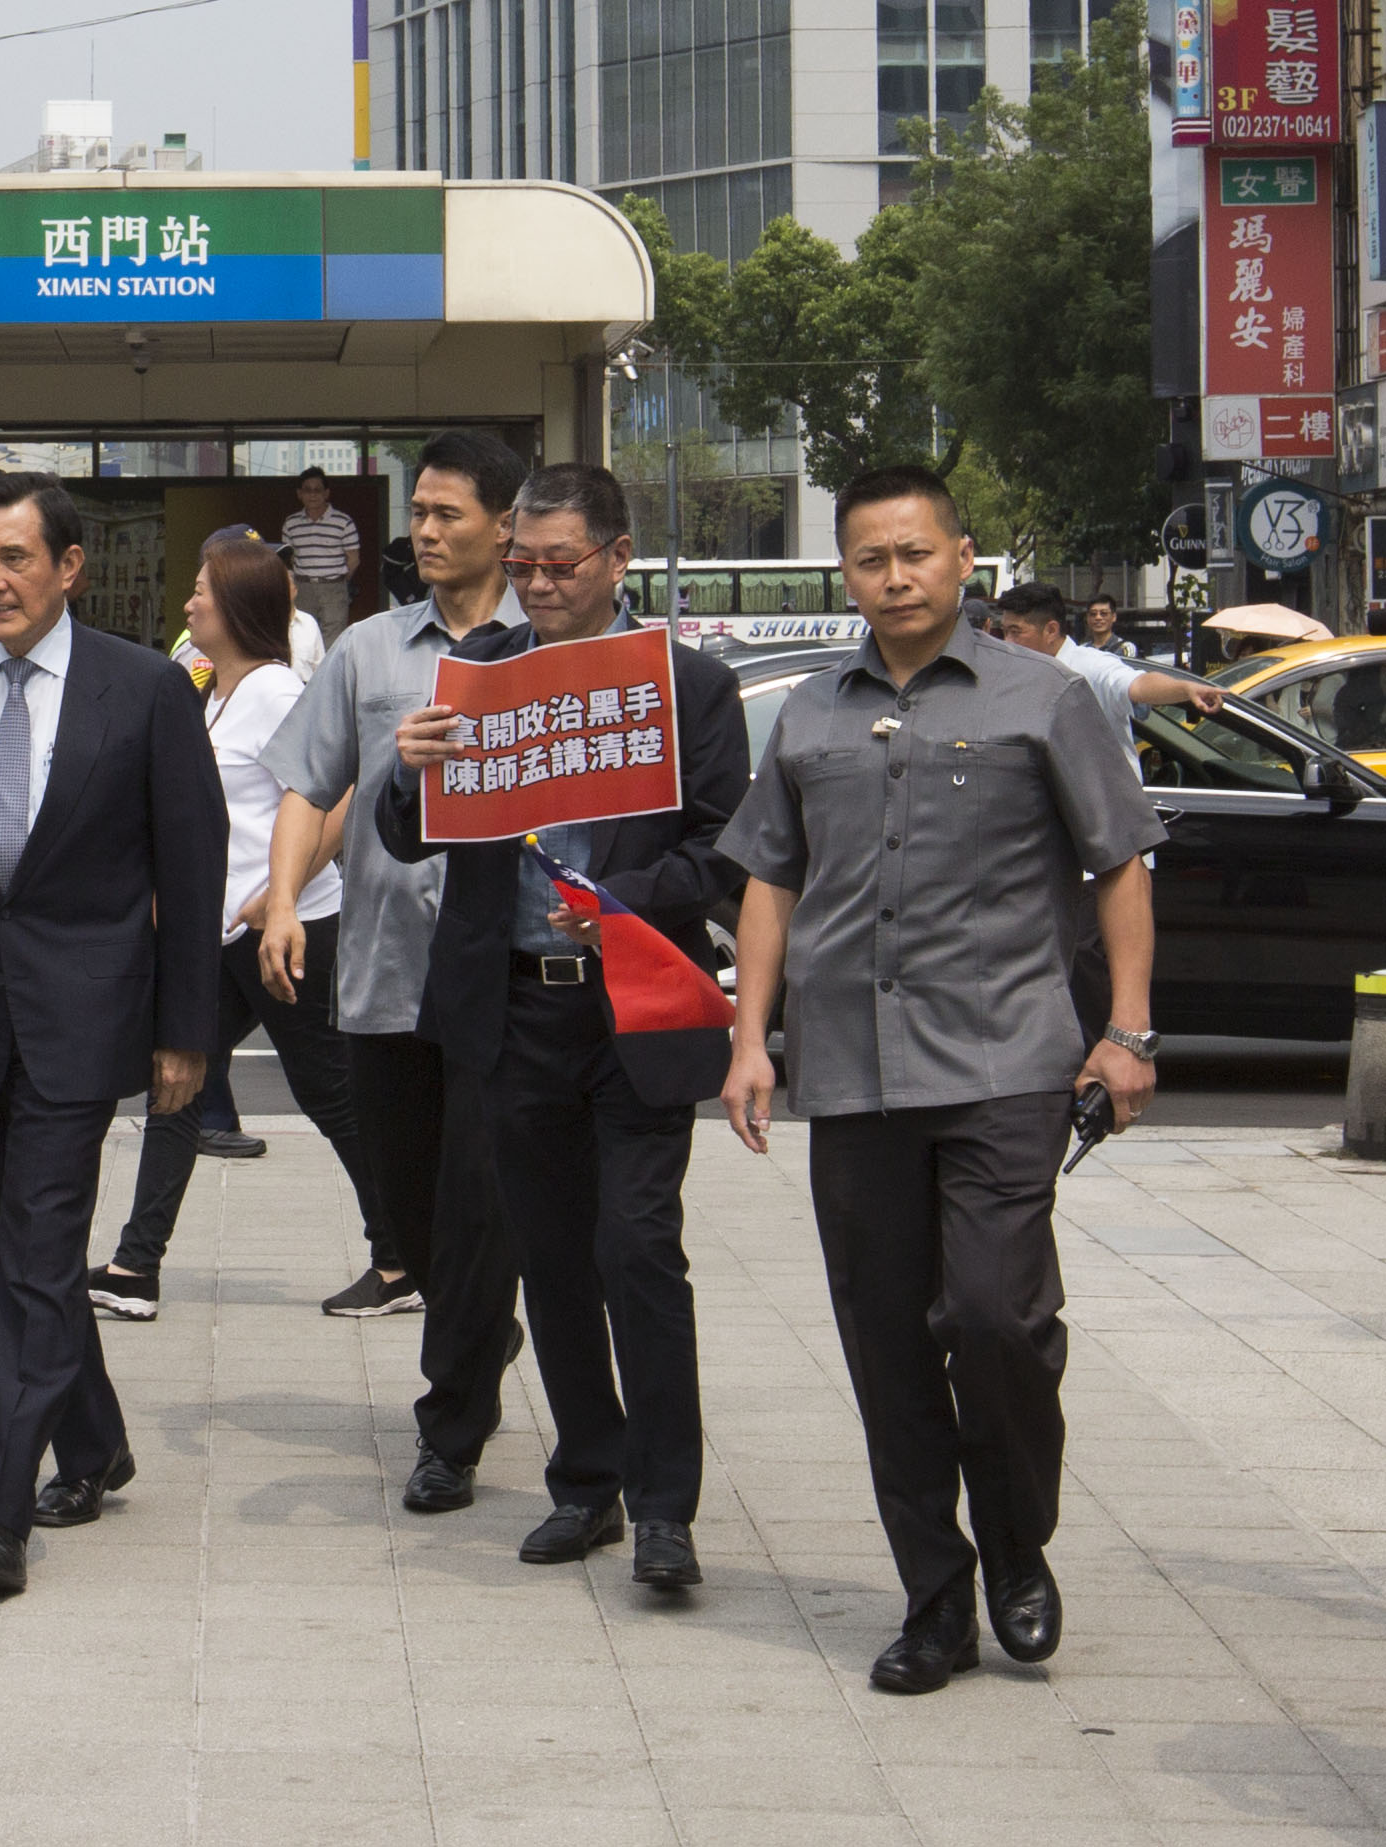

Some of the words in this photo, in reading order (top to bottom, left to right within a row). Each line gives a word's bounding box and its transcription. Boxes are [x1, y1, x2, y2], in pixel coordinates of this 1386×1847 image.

[1217, 86, 1259, 112] 3F
[1222, 114, 1331, 138] (02)2371-0641
[1231, 166, 1308, 198] 女醫
[40, 214, 211, 267] 西門站
[1228, 213, 1273, 349] 瑪麗安
[1282, 305, 1306, 389] 婦產科
[1264, 410, 1331, 443] 二樓
[748, 620, 840, 638] SHUANG
[444, 681, 663, 751] 拿開政治黑手
[441, 726, 664, 796] 陳師孟講清楚
